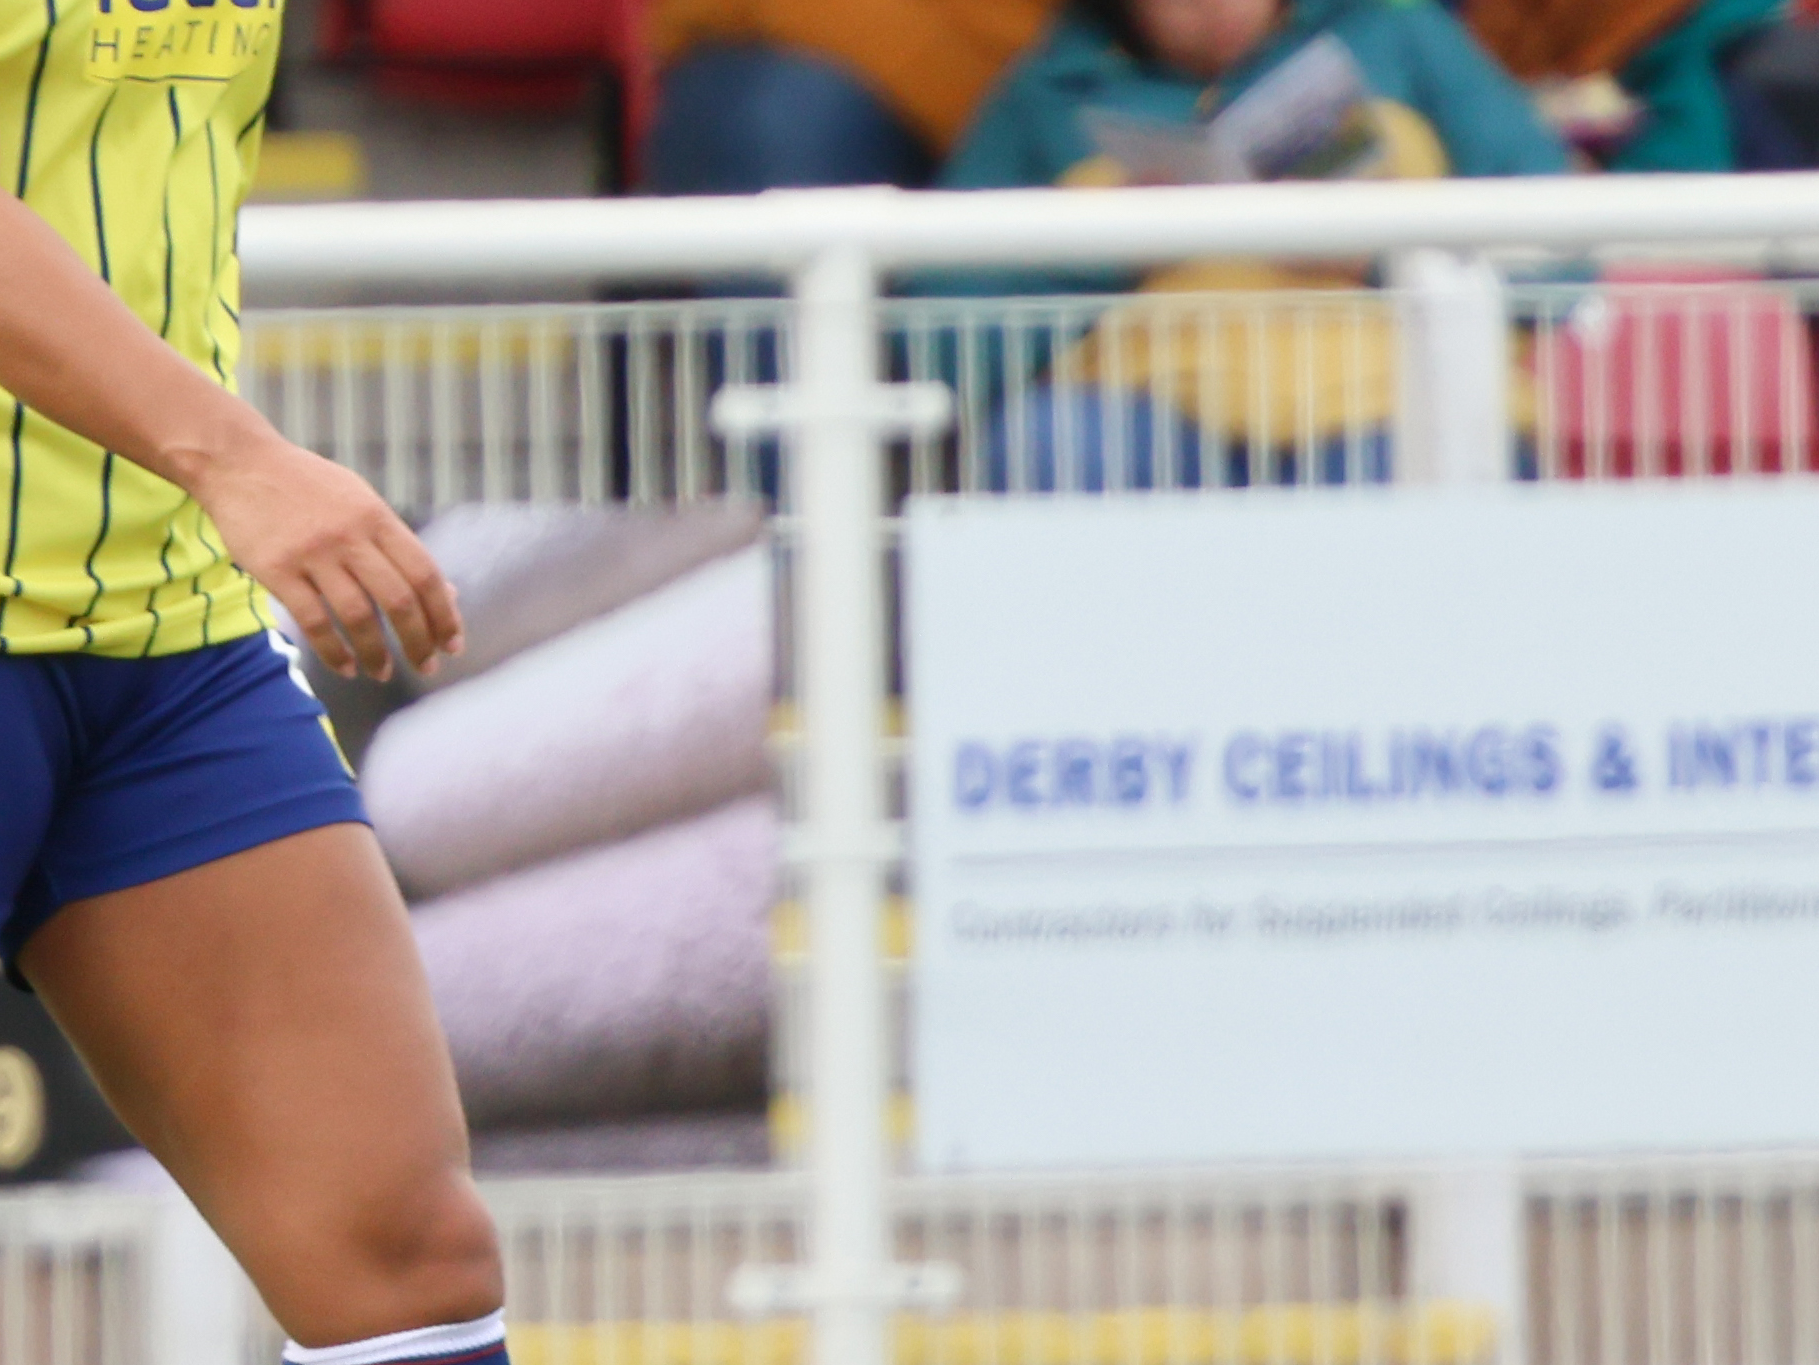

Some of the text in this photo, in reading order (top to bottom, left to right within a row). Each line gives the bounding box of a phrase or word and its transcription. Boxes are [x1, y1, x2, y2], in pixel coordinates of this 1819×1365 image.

[951, 732, 1195, 812] DERBY
[1222, 722, 1562, 802] CEILINGS
[1590, 718, 1637, 792] &
